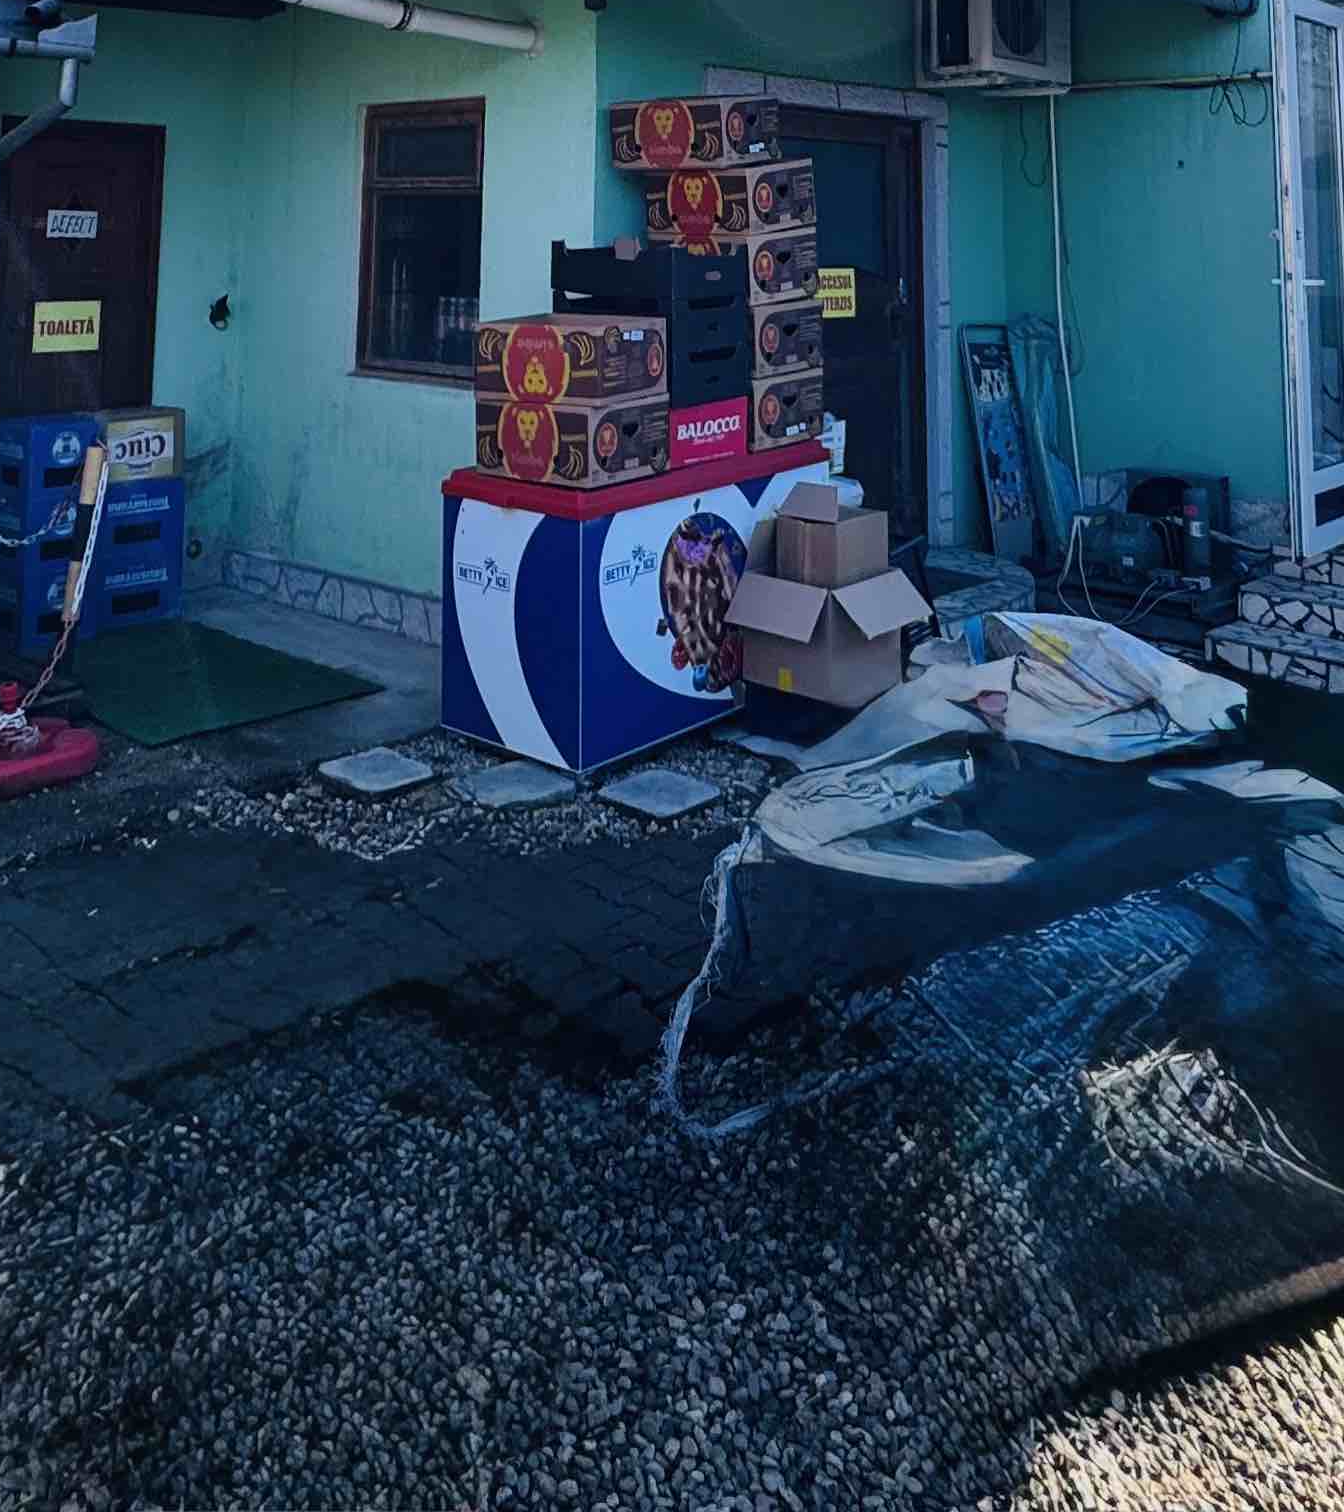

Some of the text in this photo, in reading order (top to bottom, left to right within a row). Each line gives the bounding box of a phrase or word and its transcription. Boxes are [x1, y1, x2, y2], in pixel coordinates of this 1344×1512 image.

[677, 415, 740, 440] BALOCCO
[459, 566, 507, 588] BETTY ICE
[606, 557, 655, 580] BETTY ICE
